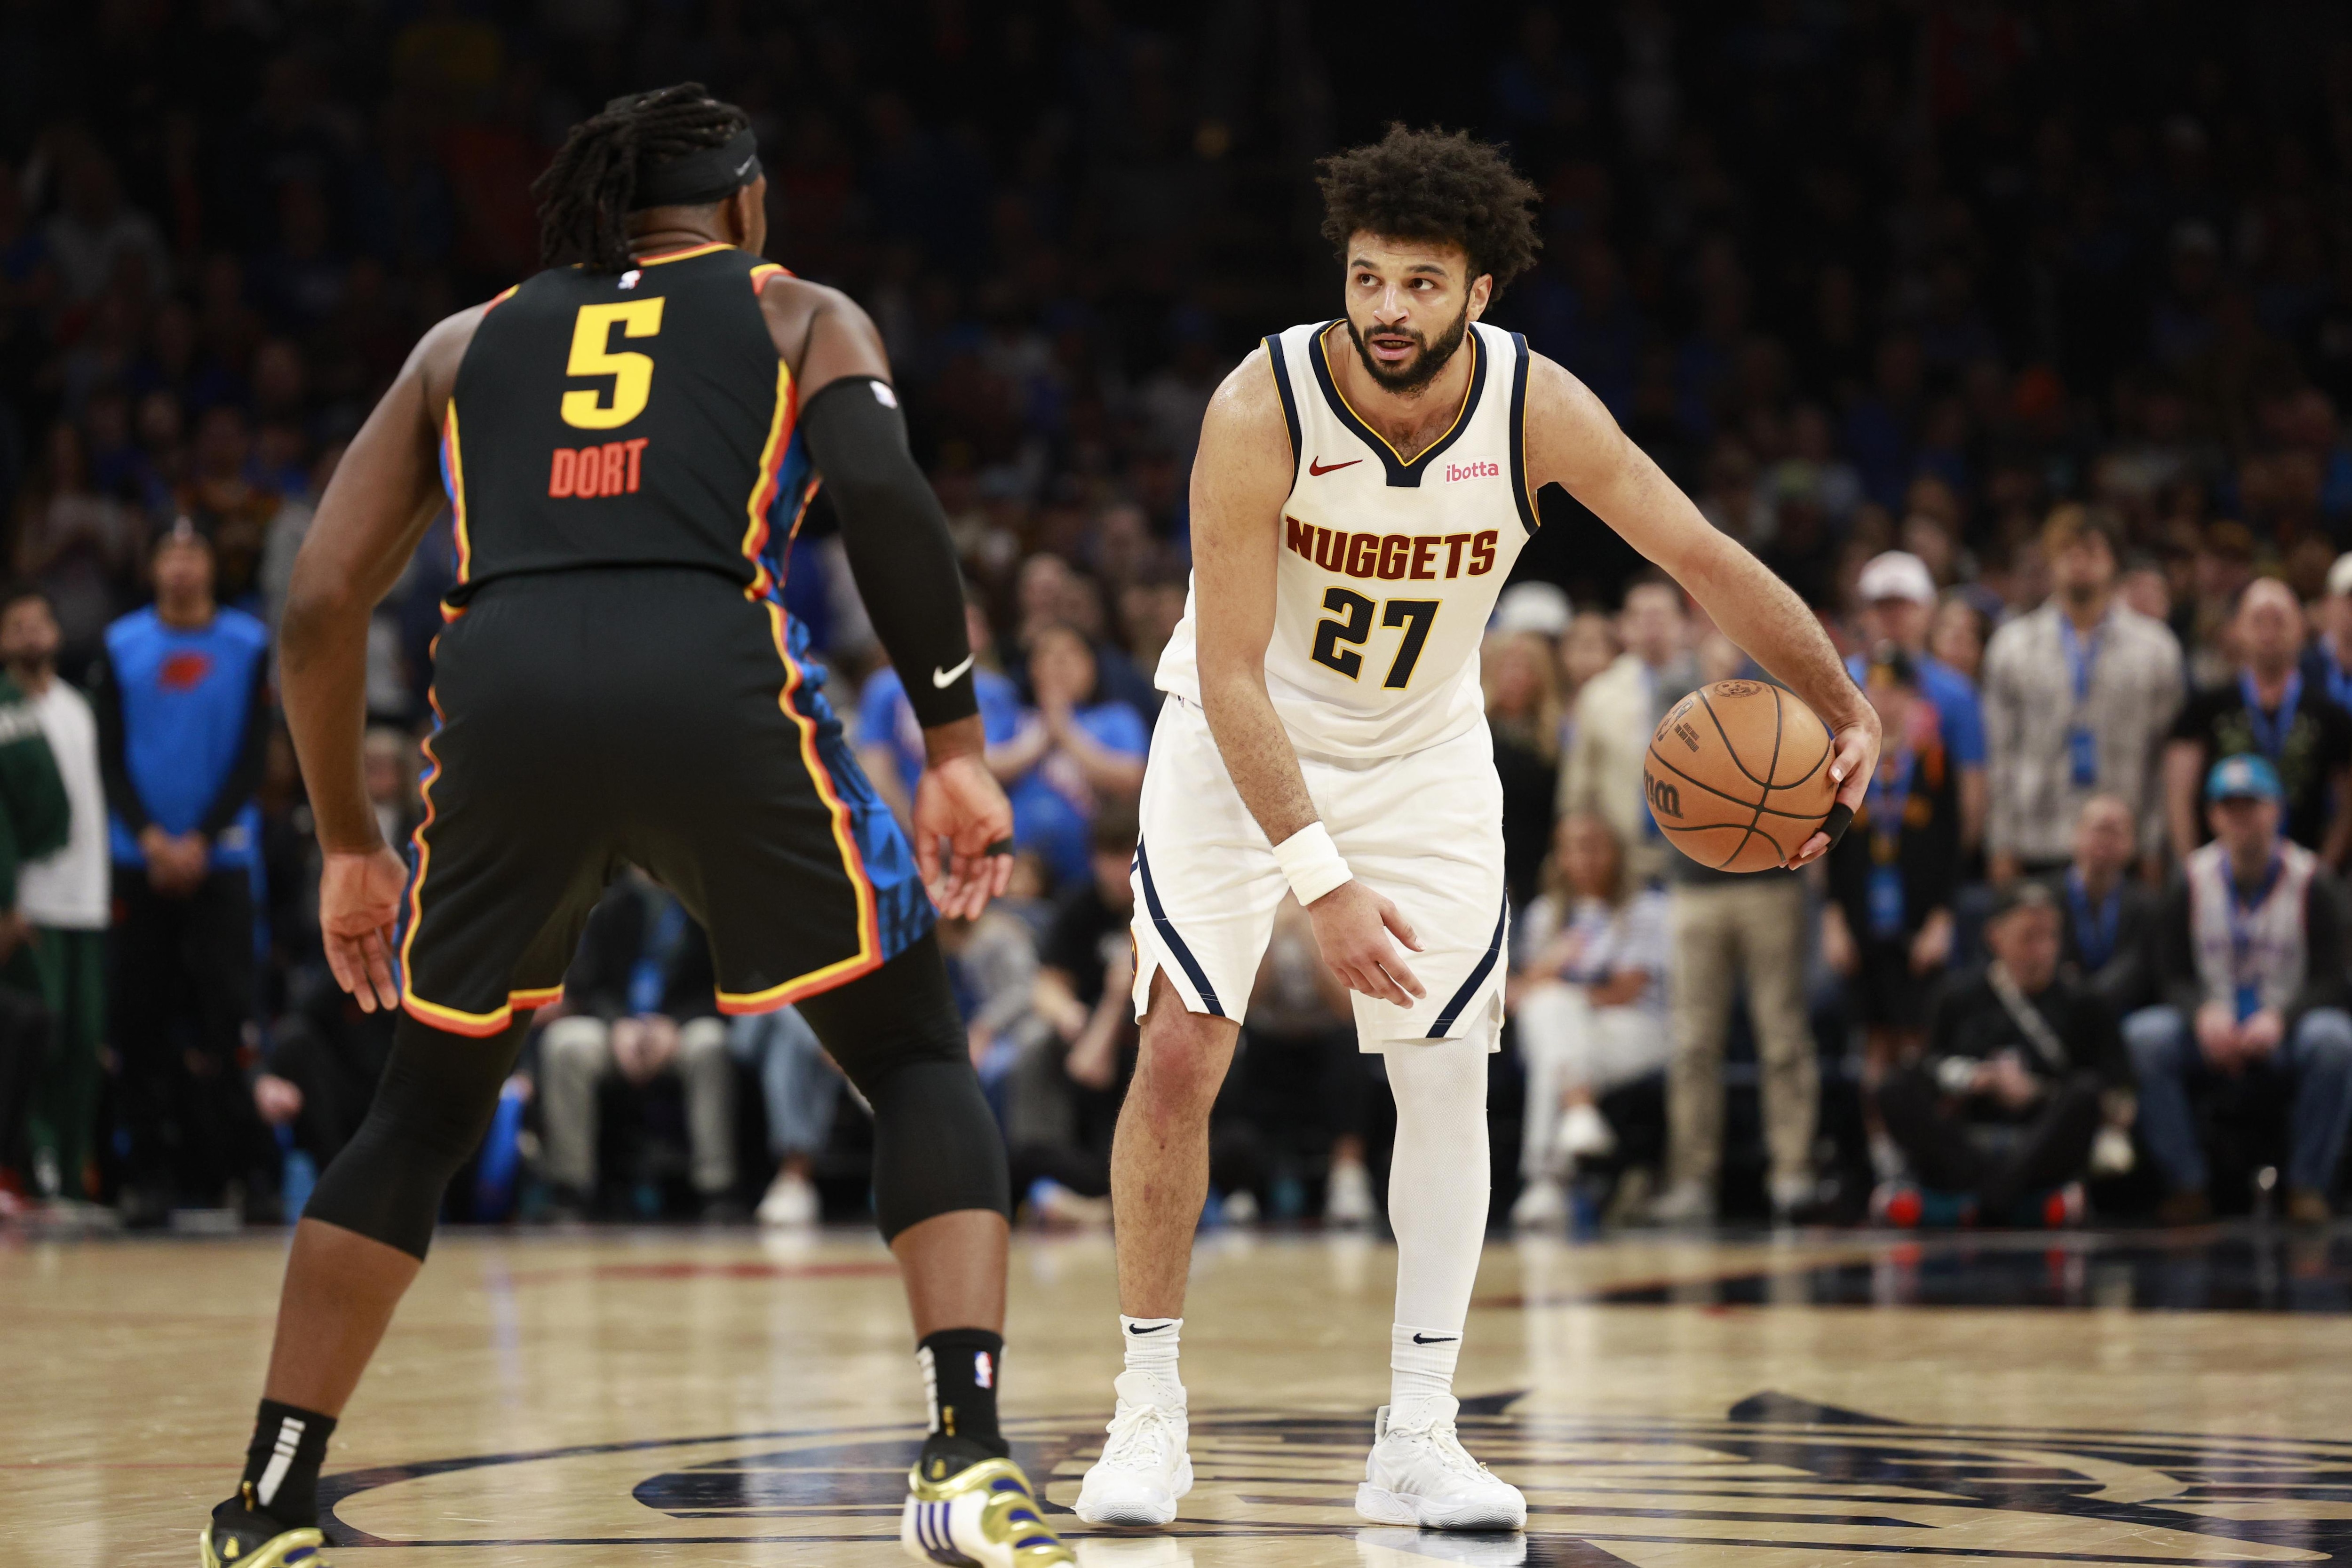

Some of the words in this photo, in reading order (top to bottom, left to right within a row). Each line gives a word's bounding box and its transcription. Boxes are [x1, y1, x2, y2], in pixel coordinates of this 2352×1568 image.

[561, 296, 665, 429] 5
[548, 437, 649, 499] DORT
[1446, 461, 1499, 482] ibotta
[1285, 513, 1499, 581] NUGGETS
[1309, 586, 1443, 690] 27
